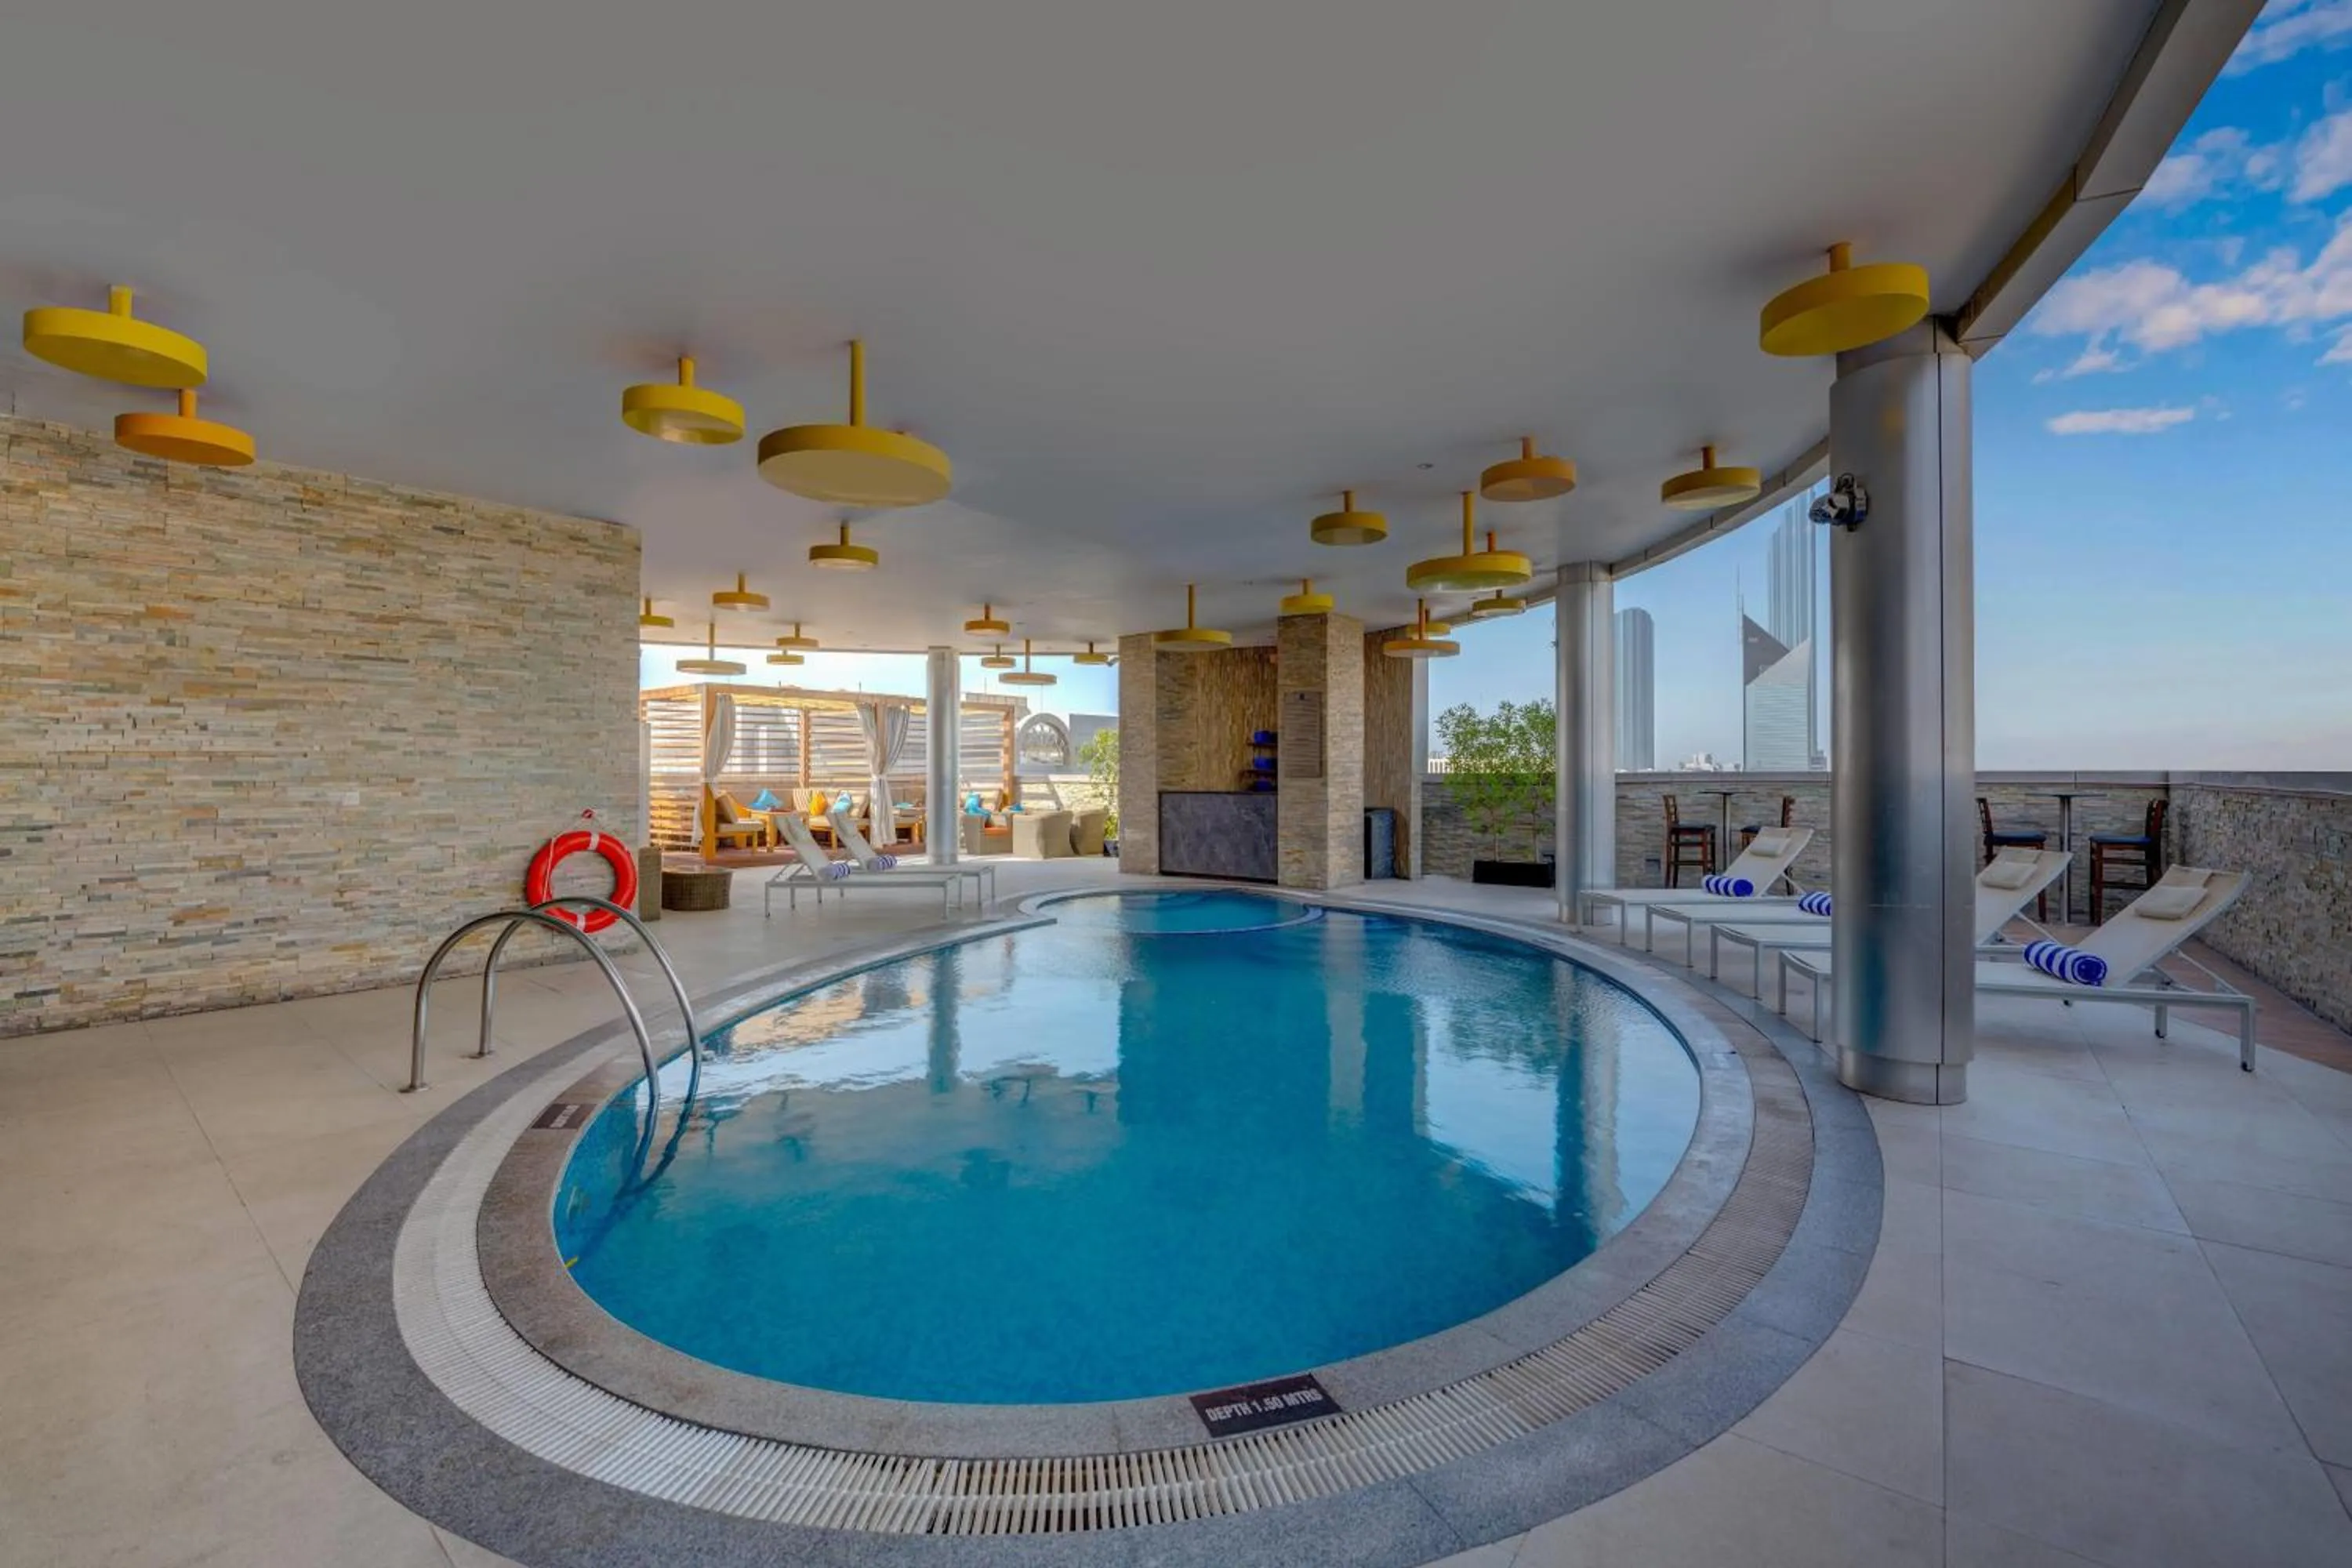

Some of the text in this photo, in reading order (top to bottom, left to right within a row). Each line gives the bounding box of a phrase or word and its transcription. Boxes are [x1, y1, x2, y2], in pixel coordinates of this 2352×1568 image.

[1205, 1388, 1324, 1422] DEPTH 1.50 MTRS
